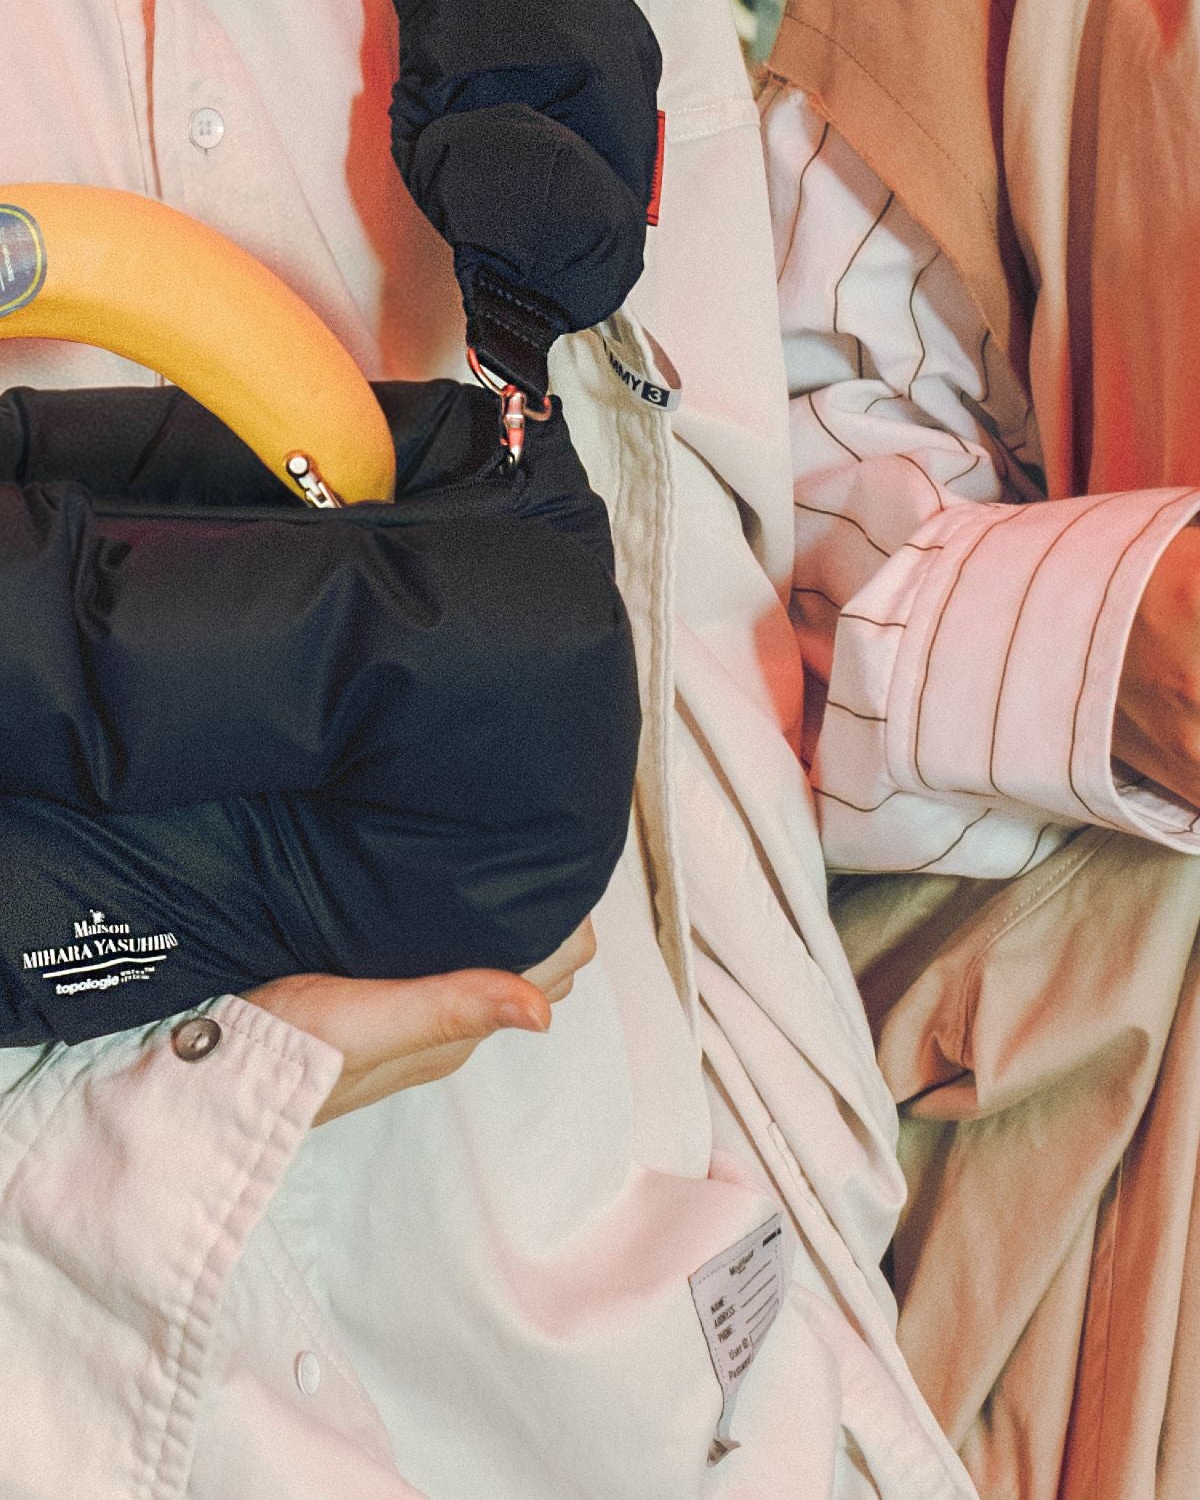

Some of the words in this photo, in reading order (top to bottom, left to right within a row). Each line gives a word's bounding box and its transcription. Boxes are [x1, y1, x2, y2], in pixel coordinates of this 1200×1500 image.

[647, 387, 663, 403] 3
[73, 920, 130, 939] Maison
[23, 943, 93, 969] MIHARA
[93, 932, 179, 956] YASUHIRO
[55, 974, 120, 995] topologie
